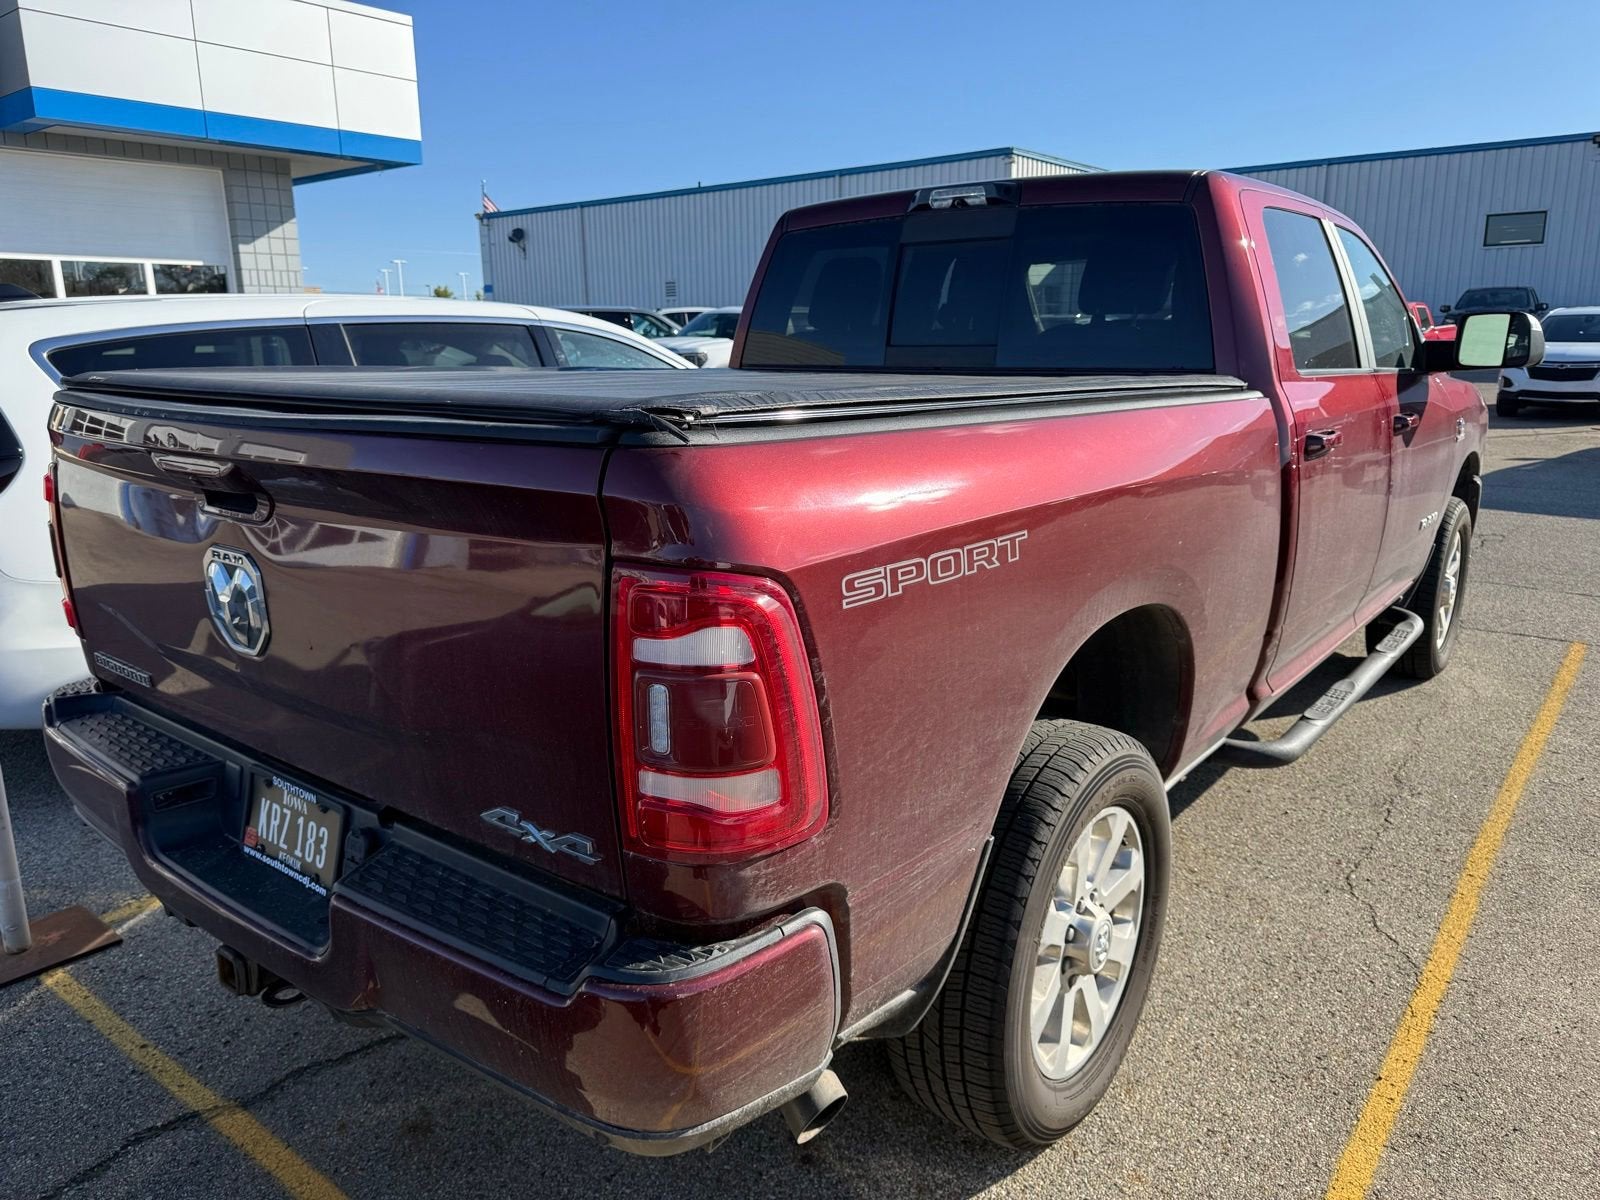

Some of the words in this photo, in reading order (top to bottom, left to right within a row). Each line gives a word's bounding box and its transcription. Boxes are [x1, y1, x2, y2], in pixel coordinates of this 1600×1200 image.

[211, 550, 244, 565] RAM
[841, 529, 1028, 609] SPORT
[272, 776, 317, 804] SOUTHTOWN
[283, 789, 308, 815] IOWA
[258, 797, 291, 850] KRZ
[294, 815, 328, 869] 183
[243, 845, 327, 897] www.southtowncdj.com
